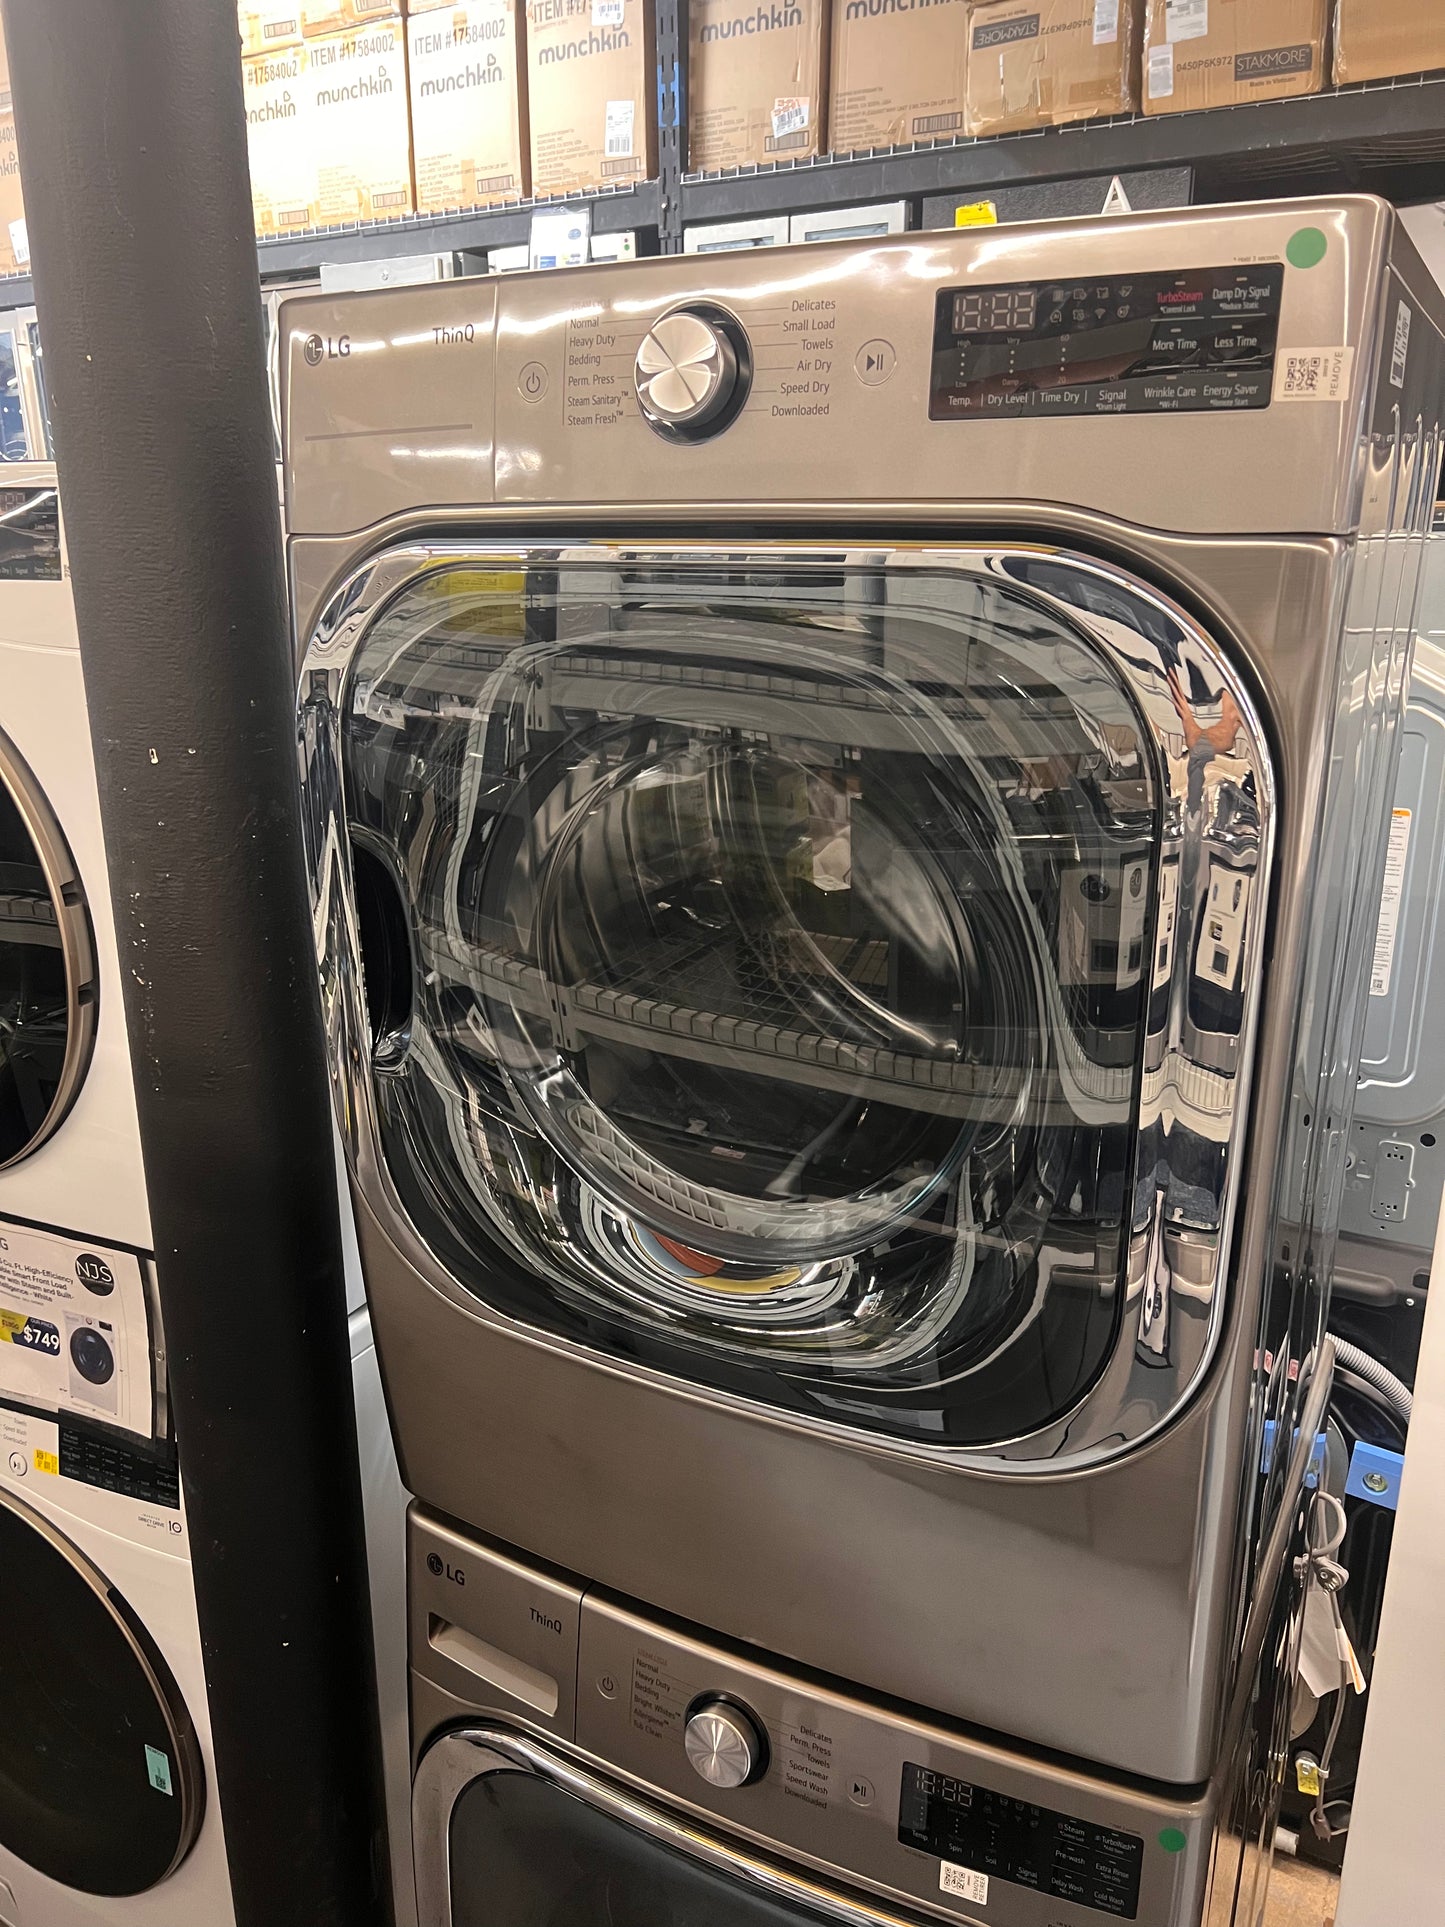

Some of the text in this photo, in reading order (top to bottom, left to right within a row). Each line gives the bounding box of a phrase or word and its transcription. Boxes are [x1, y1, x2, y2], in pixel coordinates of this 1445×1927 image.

[534, 0, 563, 23] ITEM
[701, 0, 802, 43] munchkin
[415, 33, 442, 56] ITEM
[445, 18, 506, 48] #17584002
[975, 22, 1038, 46] STAKMORE
[311, 34, 395, 67] ITEM #17584002
[539, 24, 631, 65] munchkin
[1176, 56, 1232, 72] 0450P6K972
[1236, 50, 1307, 72] STAKMORE
[248, 60, 297, 85] #17584002
[421, 53, 503, 97] munchkin
[317, 66, 393, 106] munchkin
[246, 91, 296, 124] nchkin
[1157, 291, 1203, 303] TurboSteam
[1212, 285, 1270, 301] Damp Dry Signal
[791, 300, 836, 312] Delicates
[570, 317, 599, 329] Normal
[783, 317, 835, 332] Small Load
[432, 323, 475, 345] ThinQ
[569, 334, 615, 349] Heavy Duty
[1214, 335, 1257, 348] Less Time
[327, 335, 351, 359] LG
[801, 337, 833, 350] Towels
[1152, 338, 1197, 351] More Time
[568, 354, 601, 366] Bedding
[797, 359, 832, 373] Air Dry
[568, 374, 615, 387] Perm. Press
[1329, 351, 1343, 396] REMOVE
[780, 381, 830, 396] Speed Dry
[1099, 389, 1126, 401] Signal
[1144, 386, 1197, 398] Wrinkle Care
[1203, 383, 1258, 398] Energy Saver
[568, 396, 590, 407] Steam
[948, 395, 972, 406] Temp.
[987, 392, 1028, 406] Dry Level
[1040, 391, 1080, 404] Time Dry
[771, 403, 829, 417] Downloaded
[568, 415, 593, 426] Steam
[0, 1237, 9, 1250] G
[76, 1260, 112, 1282] NJS
[23, 1324, 60, 1350] $749
[447, 1564, 465, 1586] LG
[529, 1607, 562, 1635] ThinQ
[636, 1658, 658, 1673] Normal
[635, 1670, 670, 1692] Heavy Duty
[634, 1681, 659, 1700] Bedding
[800, 1725, 832, 1744] Delicates
[790, 1734, 832, 1757] Perm. Press
[807, 1753, 830, 1768] Towels
[789, 1759, 829, 1781] Sportswear
[786, 1772, 828, 1795] Speed Wash
[784, 1786, 827, 1809] Downloaded
[1064, 1823, 1085, 1836] Steam
[948, 1842, 963, 1853] Spin
[985, 1855, 997, 1865] Soil
[1055, 1849, 1085, 1865] Pre-wash
[1018, 1866, 1038, 1879] Signal
[1095, 1862, 1129, 1878] Extra Rinse
[1051, 1877, 1067, 1889] Delay
[1068, 1881, 1084, 1893] Wash
[1094, 1891, 1125, 1906] Cold Wash
